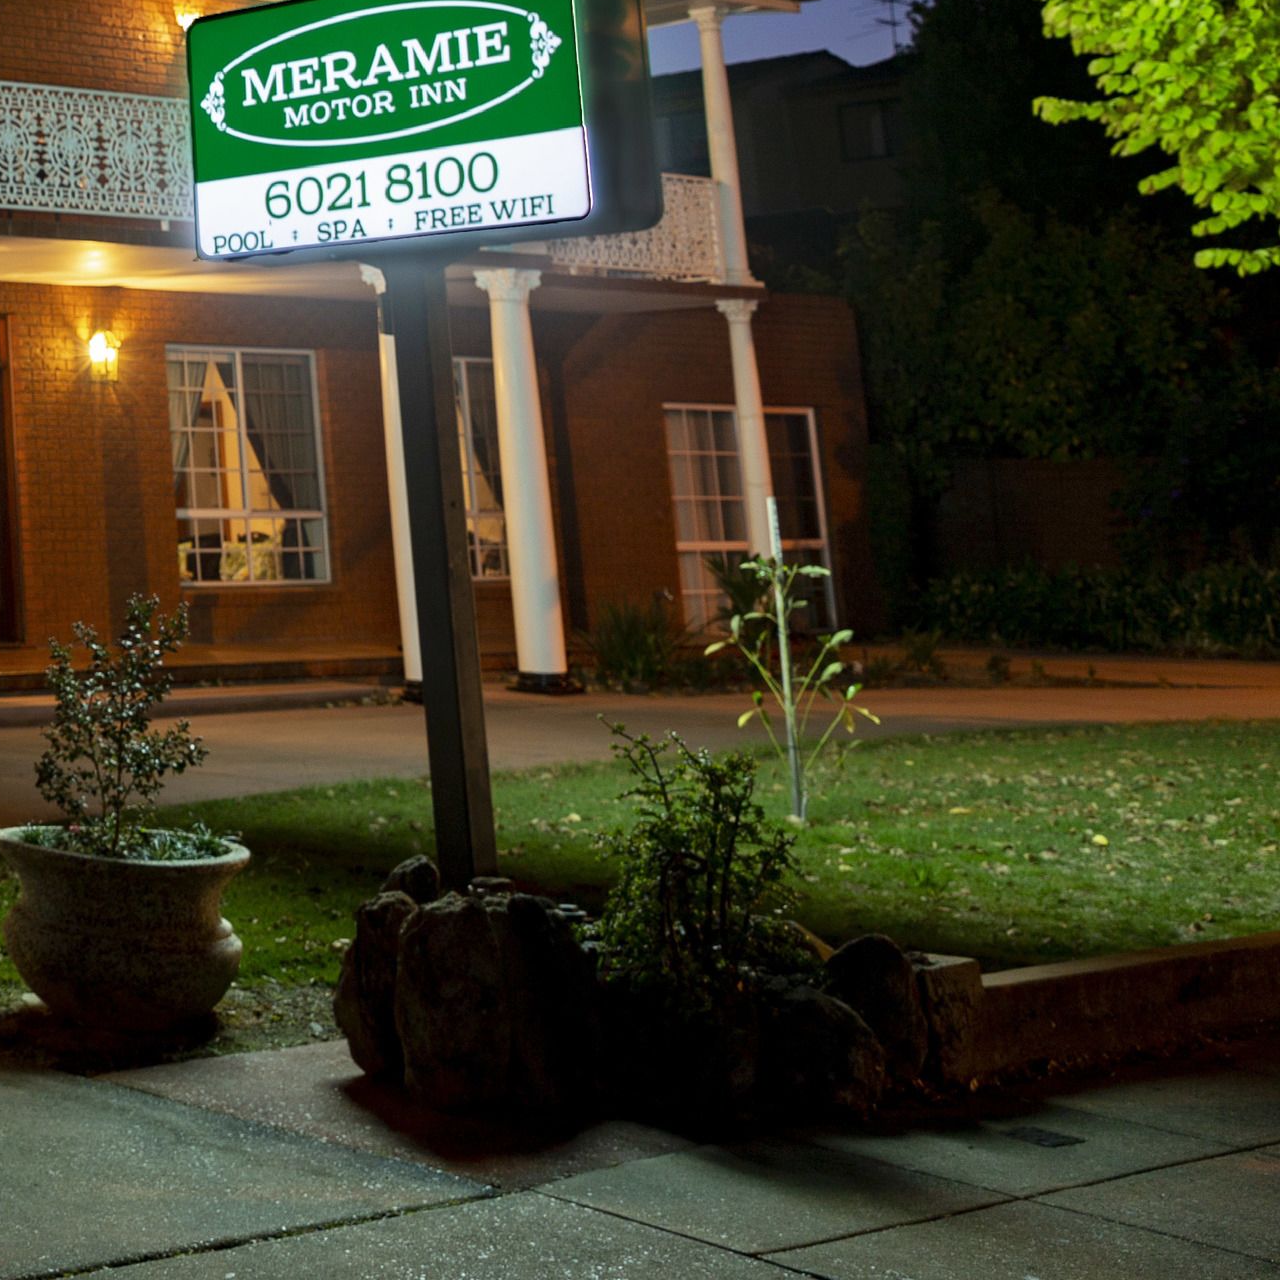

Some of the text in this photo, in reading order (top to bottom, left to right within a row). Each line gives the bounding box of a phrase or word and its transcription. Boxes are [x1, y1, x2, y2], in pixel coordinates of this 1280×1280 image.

[242, 21, 510, 107] MERAMIE
[283, 77, 468, 129] MOTOR INN
[265, 151, 499, 220] 6021 8100
[213, 194, 555, 255] POOL SPA FREE WIFI
